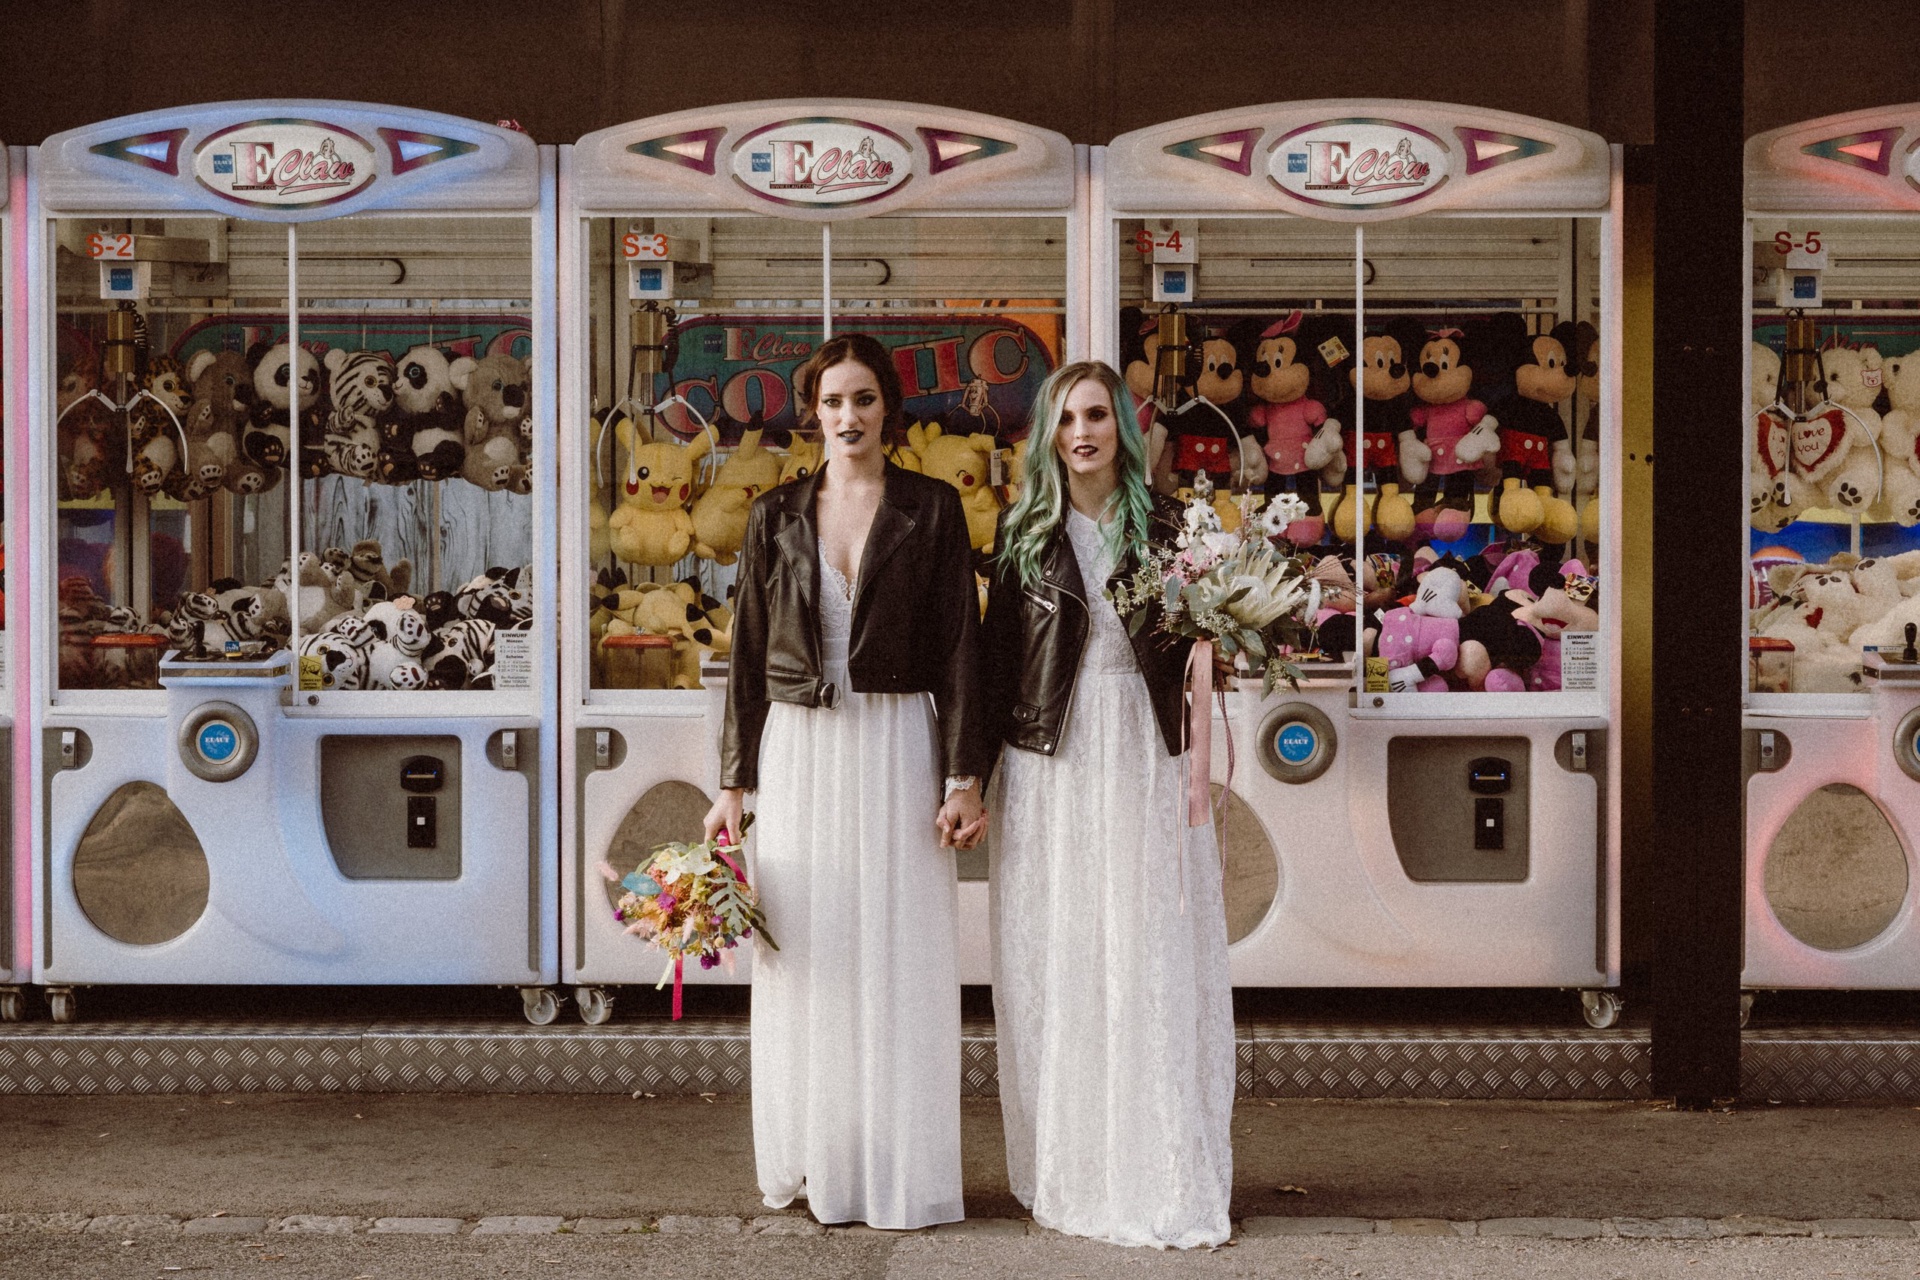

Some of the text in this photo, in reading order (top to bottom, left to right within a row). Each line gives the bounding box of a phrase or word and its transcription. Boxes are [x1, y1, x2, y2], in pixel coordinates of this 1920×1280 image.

[86, 233, 132, 257] S-2
[622, 233, 669, 257] S-3
[1136, 230, 1183, 253] S-4
[1775, 231, 1821, 255] S-5
[660, 326, 1030, 433] COIC
